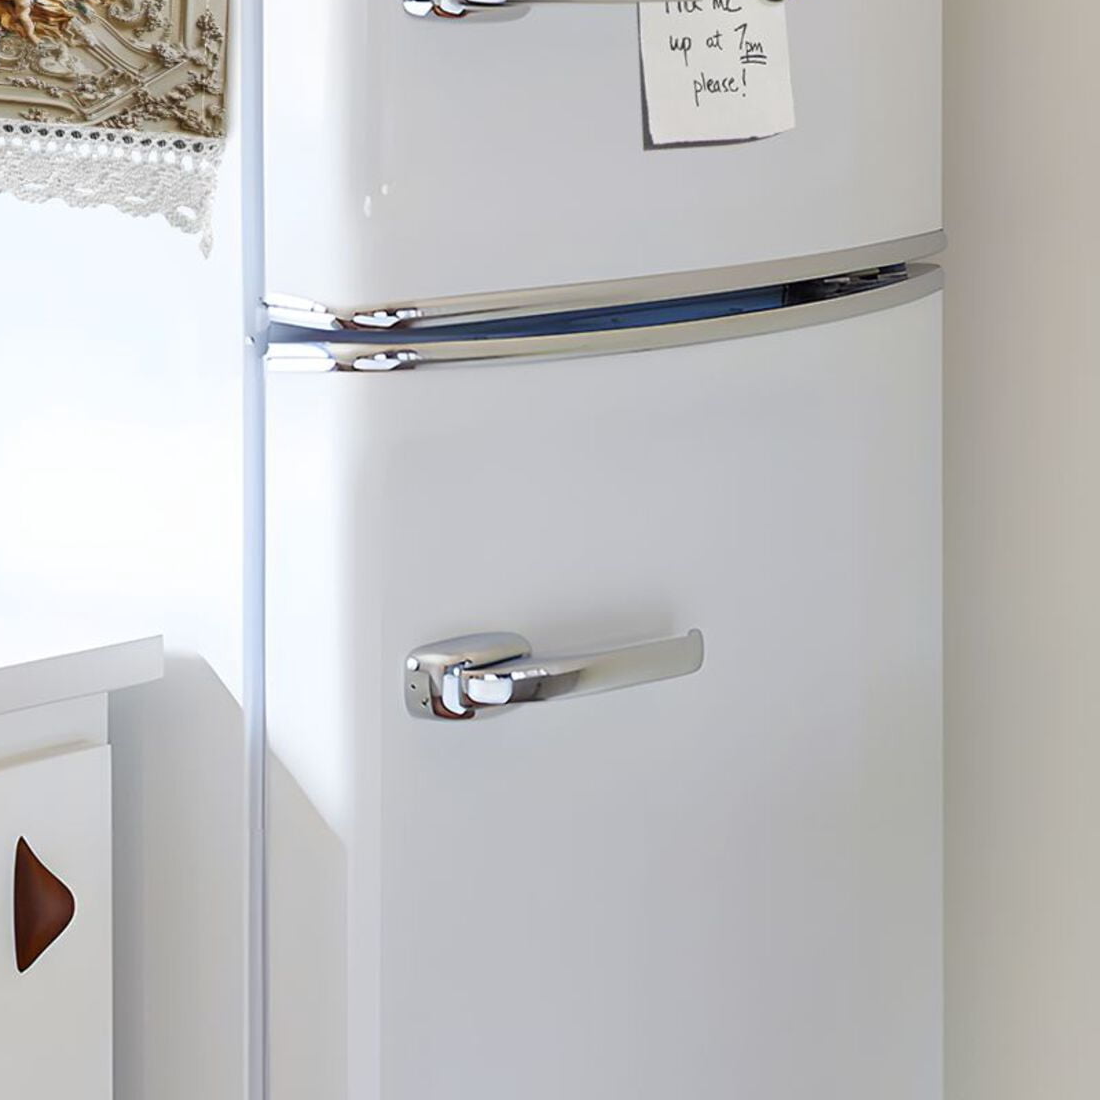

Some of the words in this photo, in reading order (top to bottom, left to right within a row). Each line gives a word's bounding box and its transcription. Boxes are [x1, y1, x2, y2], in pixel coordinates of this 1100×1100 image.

[669, 35, 692, 67] up
[706, 30, 723, 51] at
[693, 68, 747, 107] please!
